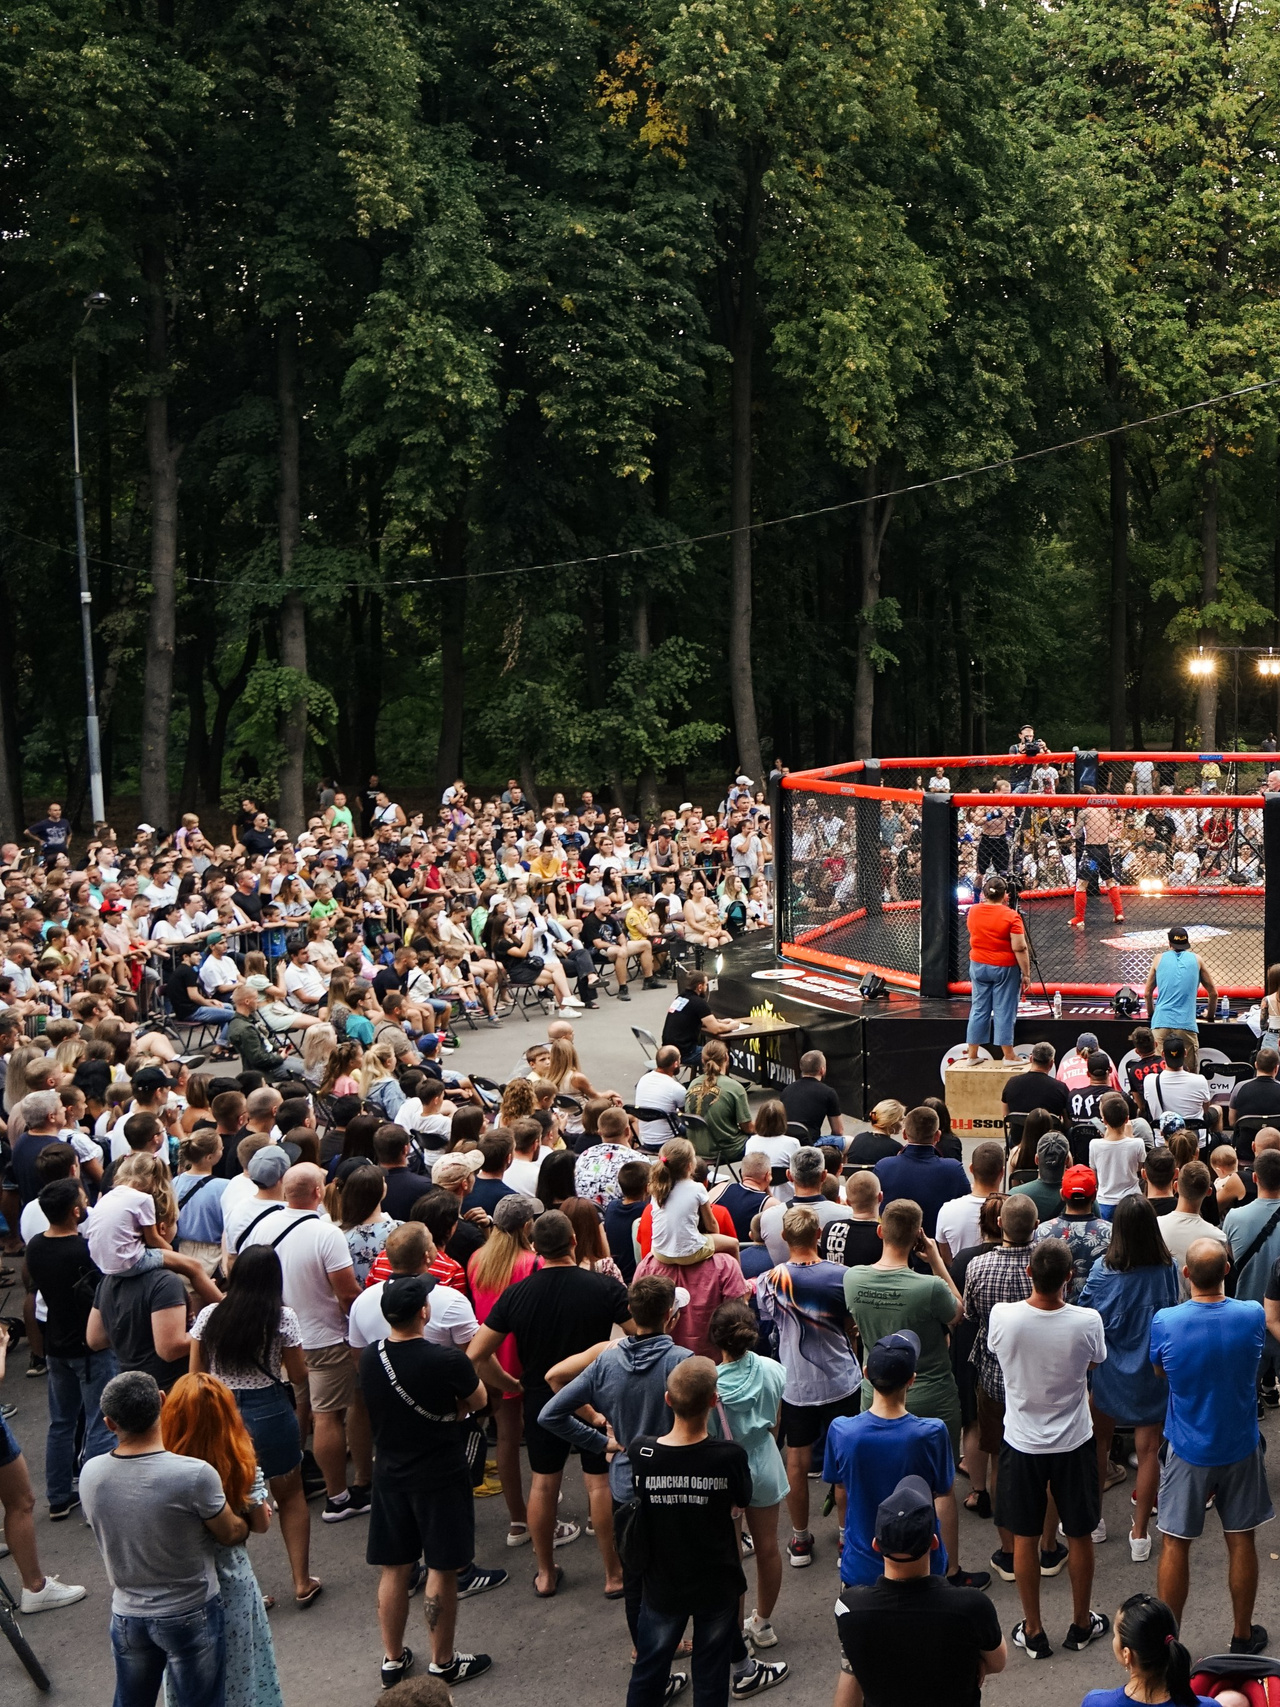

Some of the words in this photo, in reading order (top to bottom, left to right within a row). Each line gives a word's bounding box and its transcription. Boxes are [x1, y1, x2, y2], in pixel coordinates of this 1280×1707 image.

[858, 1291, 888, 1299] adidas
[690, 1476, 728, 1490] ОБОРОНА
[649, 1494, 662, 1504] ВСЕ
[662, 1494, 678, 1505] ИДЕТ
[688, 1495, 709, 1505] ПЛАНУ
